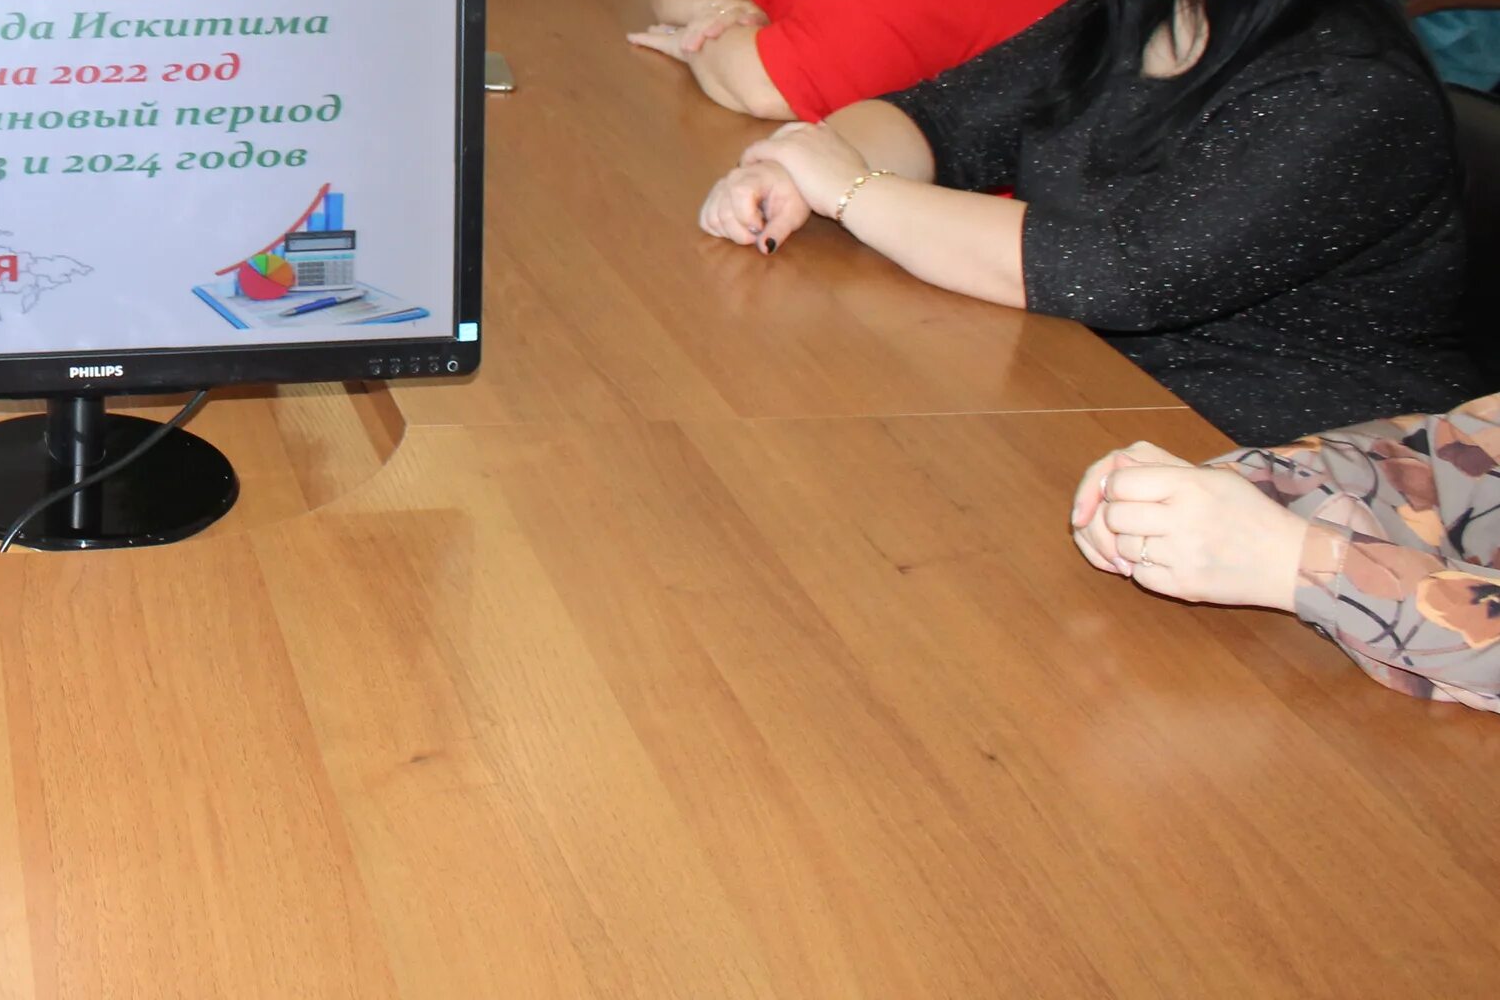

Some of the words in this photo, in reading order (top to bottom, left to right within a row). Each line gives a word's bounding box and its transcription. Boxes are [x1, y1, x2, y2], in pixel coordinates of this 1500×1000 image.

[68, 11, 329, 41] Искитима
[49, 63, 148, 85] 2022
[161, 53, 241, 83] год
[174, 94, 343, 134] период
[22, 154, 50, 176] и
[61, 152, 162, 180] 2024
[174, 141, 308, 171] годов
[69, 365, 124, 379] PHILIPS
